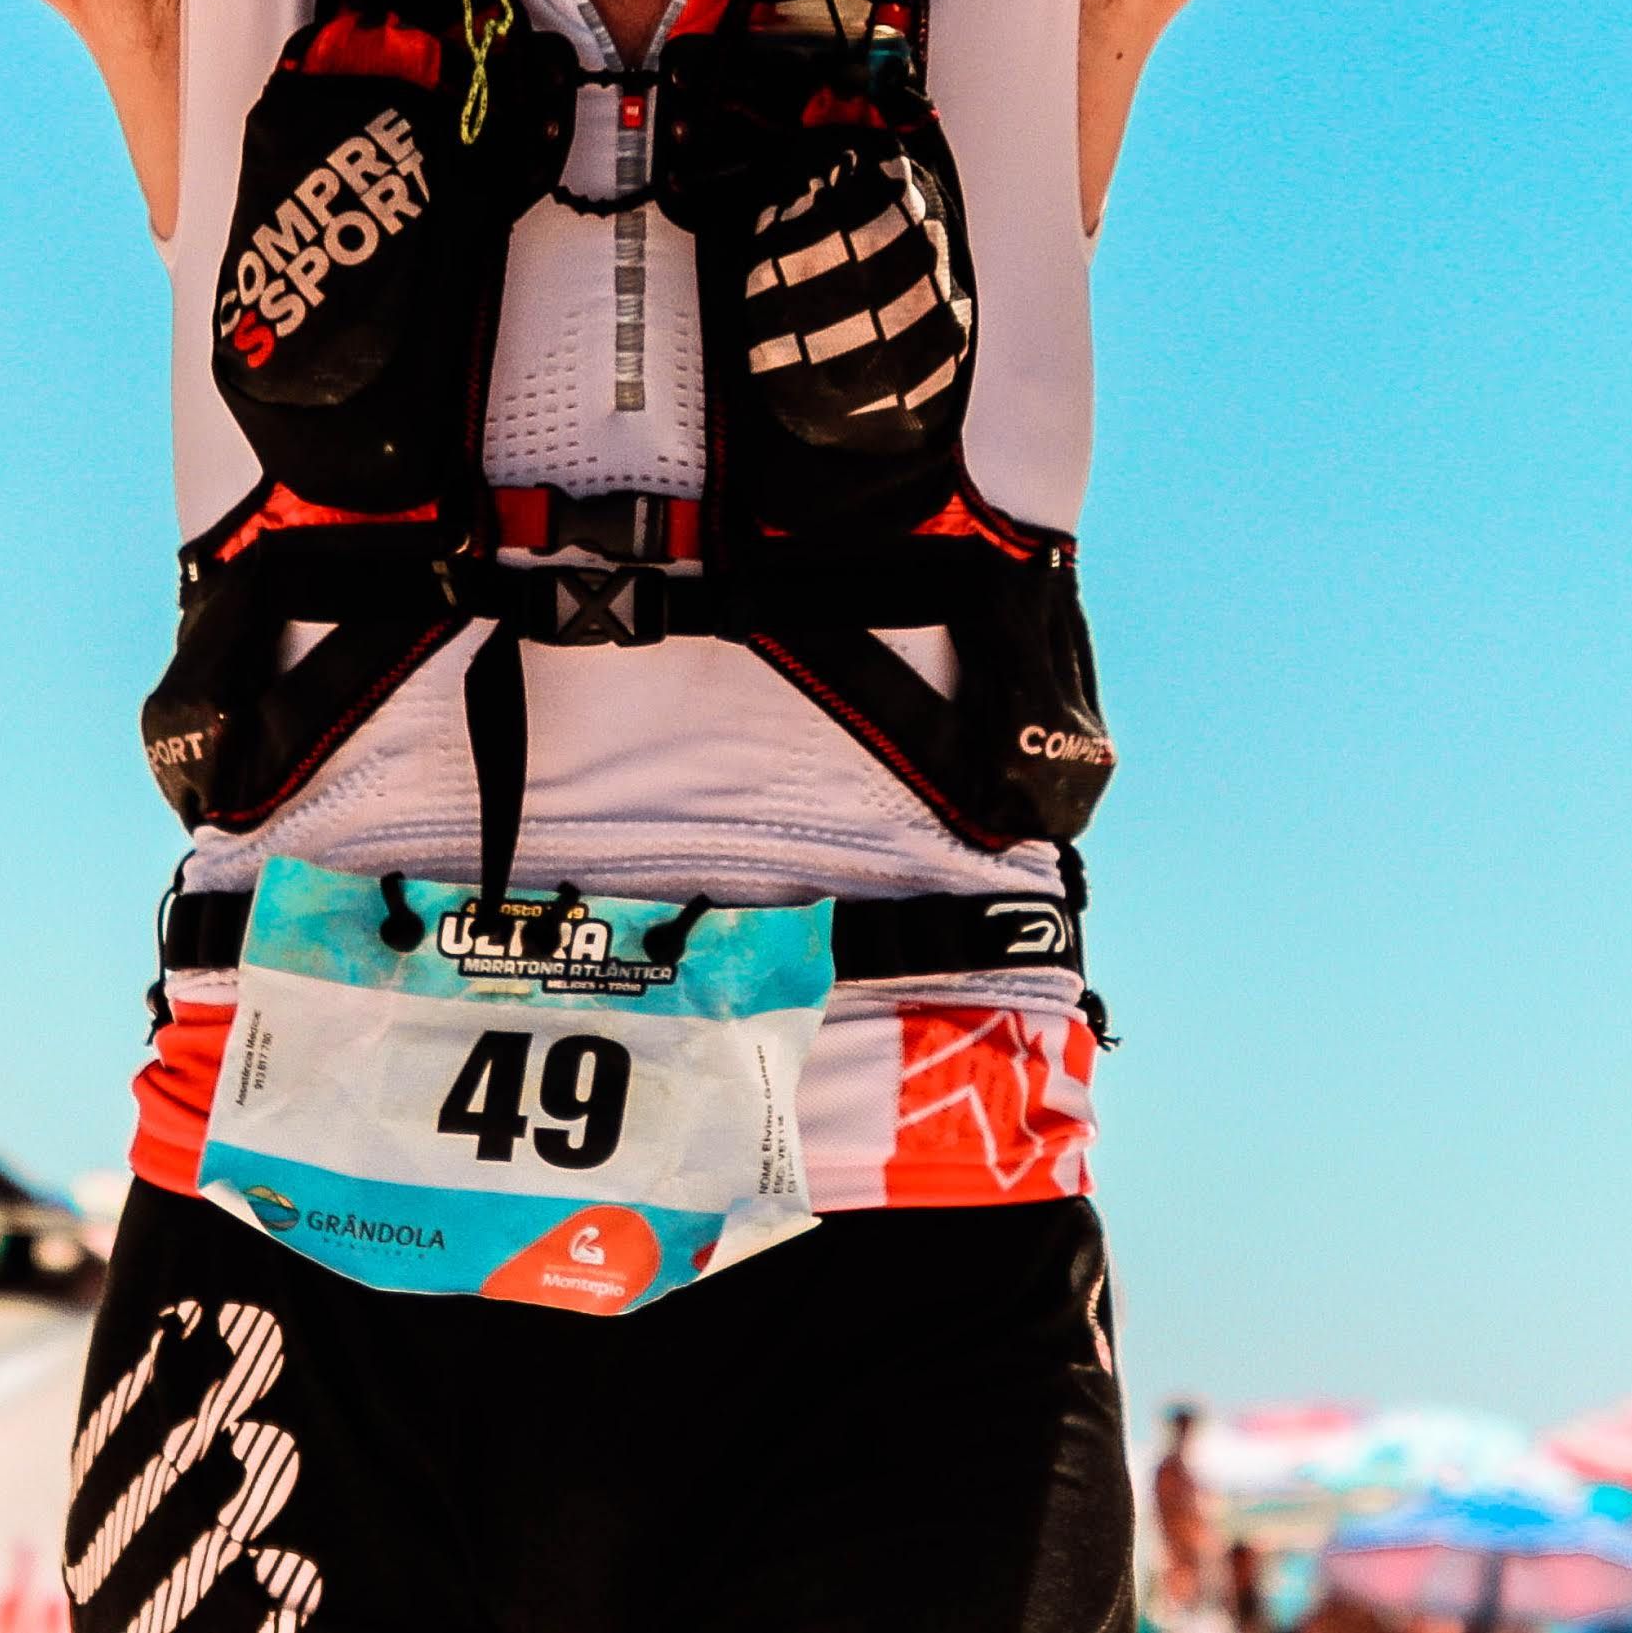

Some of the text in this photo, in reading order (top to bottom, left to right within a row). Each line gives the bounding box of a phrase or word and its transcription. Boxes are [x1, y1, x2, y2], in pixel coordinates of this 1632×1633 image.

[220, 108, 415, 338] COMPRE
[463, 958, 673, 981] MARATONA ATLÂNTICA
[437, 1030, 632, 1170] 49
[307, 1210, 446, 1250] GRÂNDOLA
